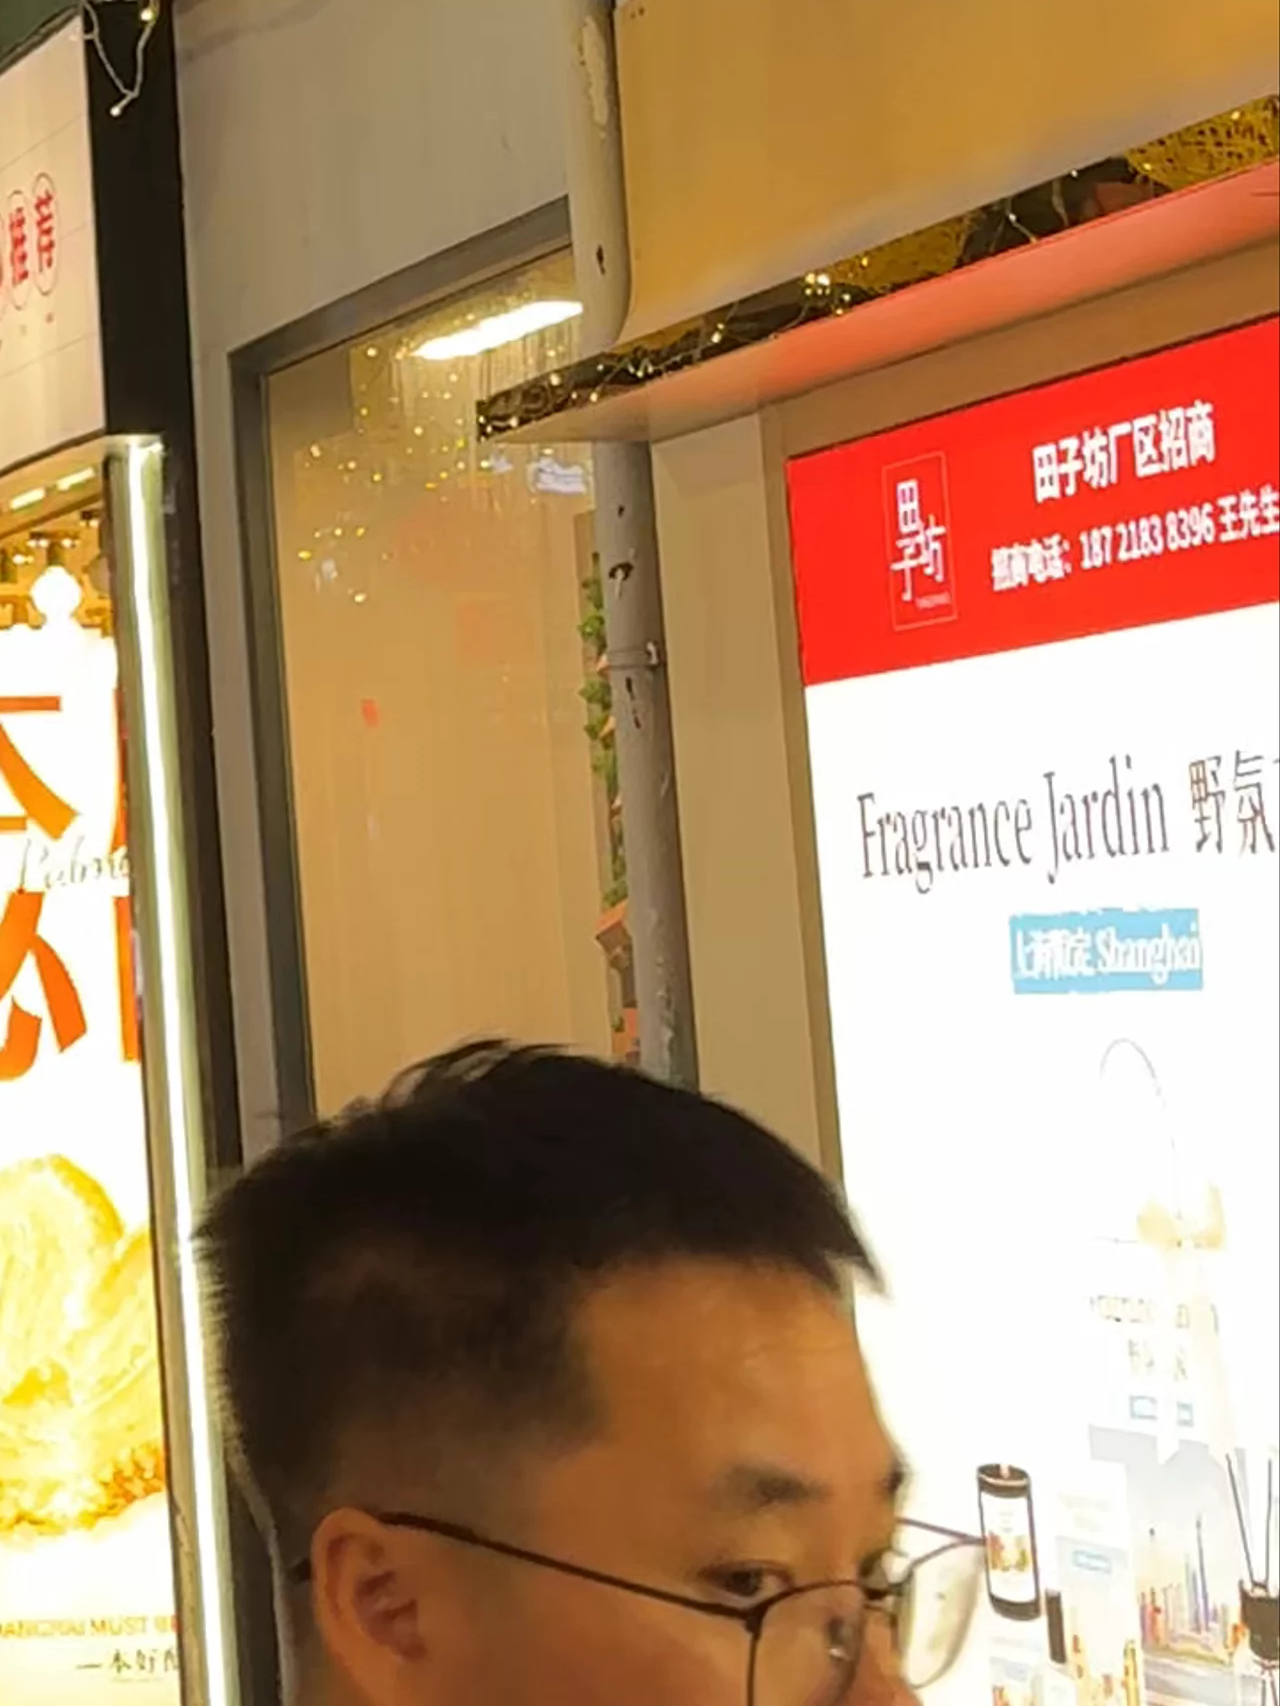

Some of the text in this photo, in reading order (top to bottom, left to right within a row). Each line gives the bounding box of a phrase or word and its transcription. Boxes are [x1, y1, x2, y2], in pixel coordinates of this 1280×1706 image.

[1032, 399, 1216, 503] 田子坊厂区招商
[1080, 526, 1113, 570] 187
[1115, 514, 1164, 562] 2183
[1166, 502, 1216, 551] 8396
[857, 750, 1280, 895] Fragrance Jardin 野氛
[1097, 921, 1201, 987] Shanghai
